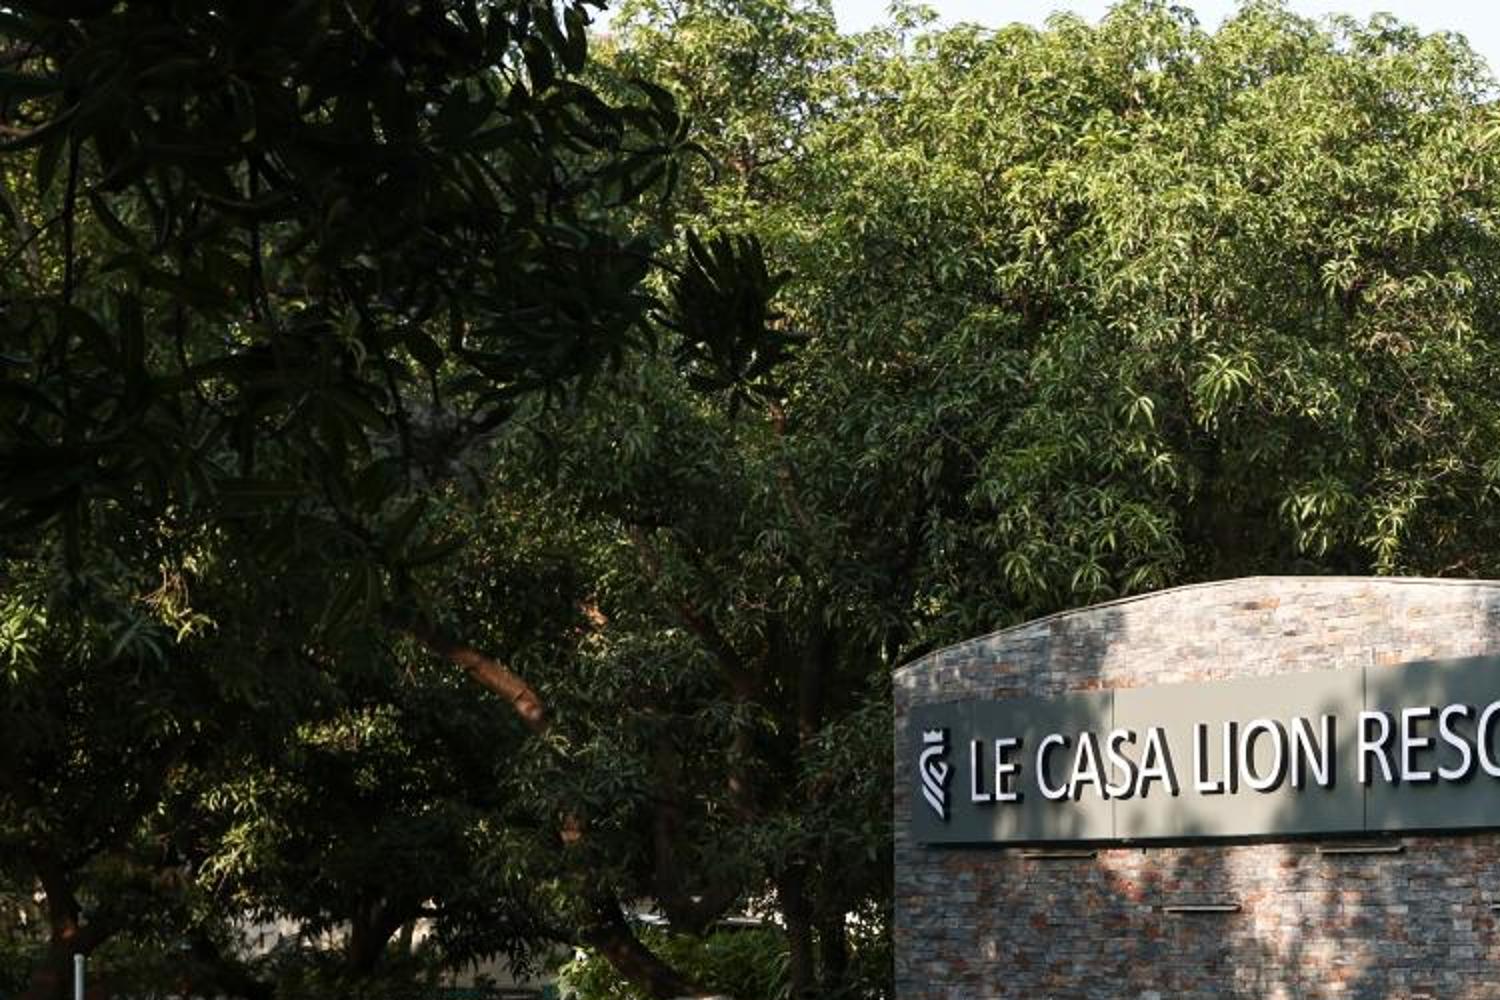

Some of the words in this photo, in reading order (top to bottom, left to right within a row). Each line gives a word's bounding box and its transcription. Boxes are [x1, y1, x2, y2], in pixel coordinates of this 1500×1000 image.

[970, 737, 1018, 802] LE
[1037, 727, 1175, 801] CASA
[1193, 715, 1330, 793] LION
